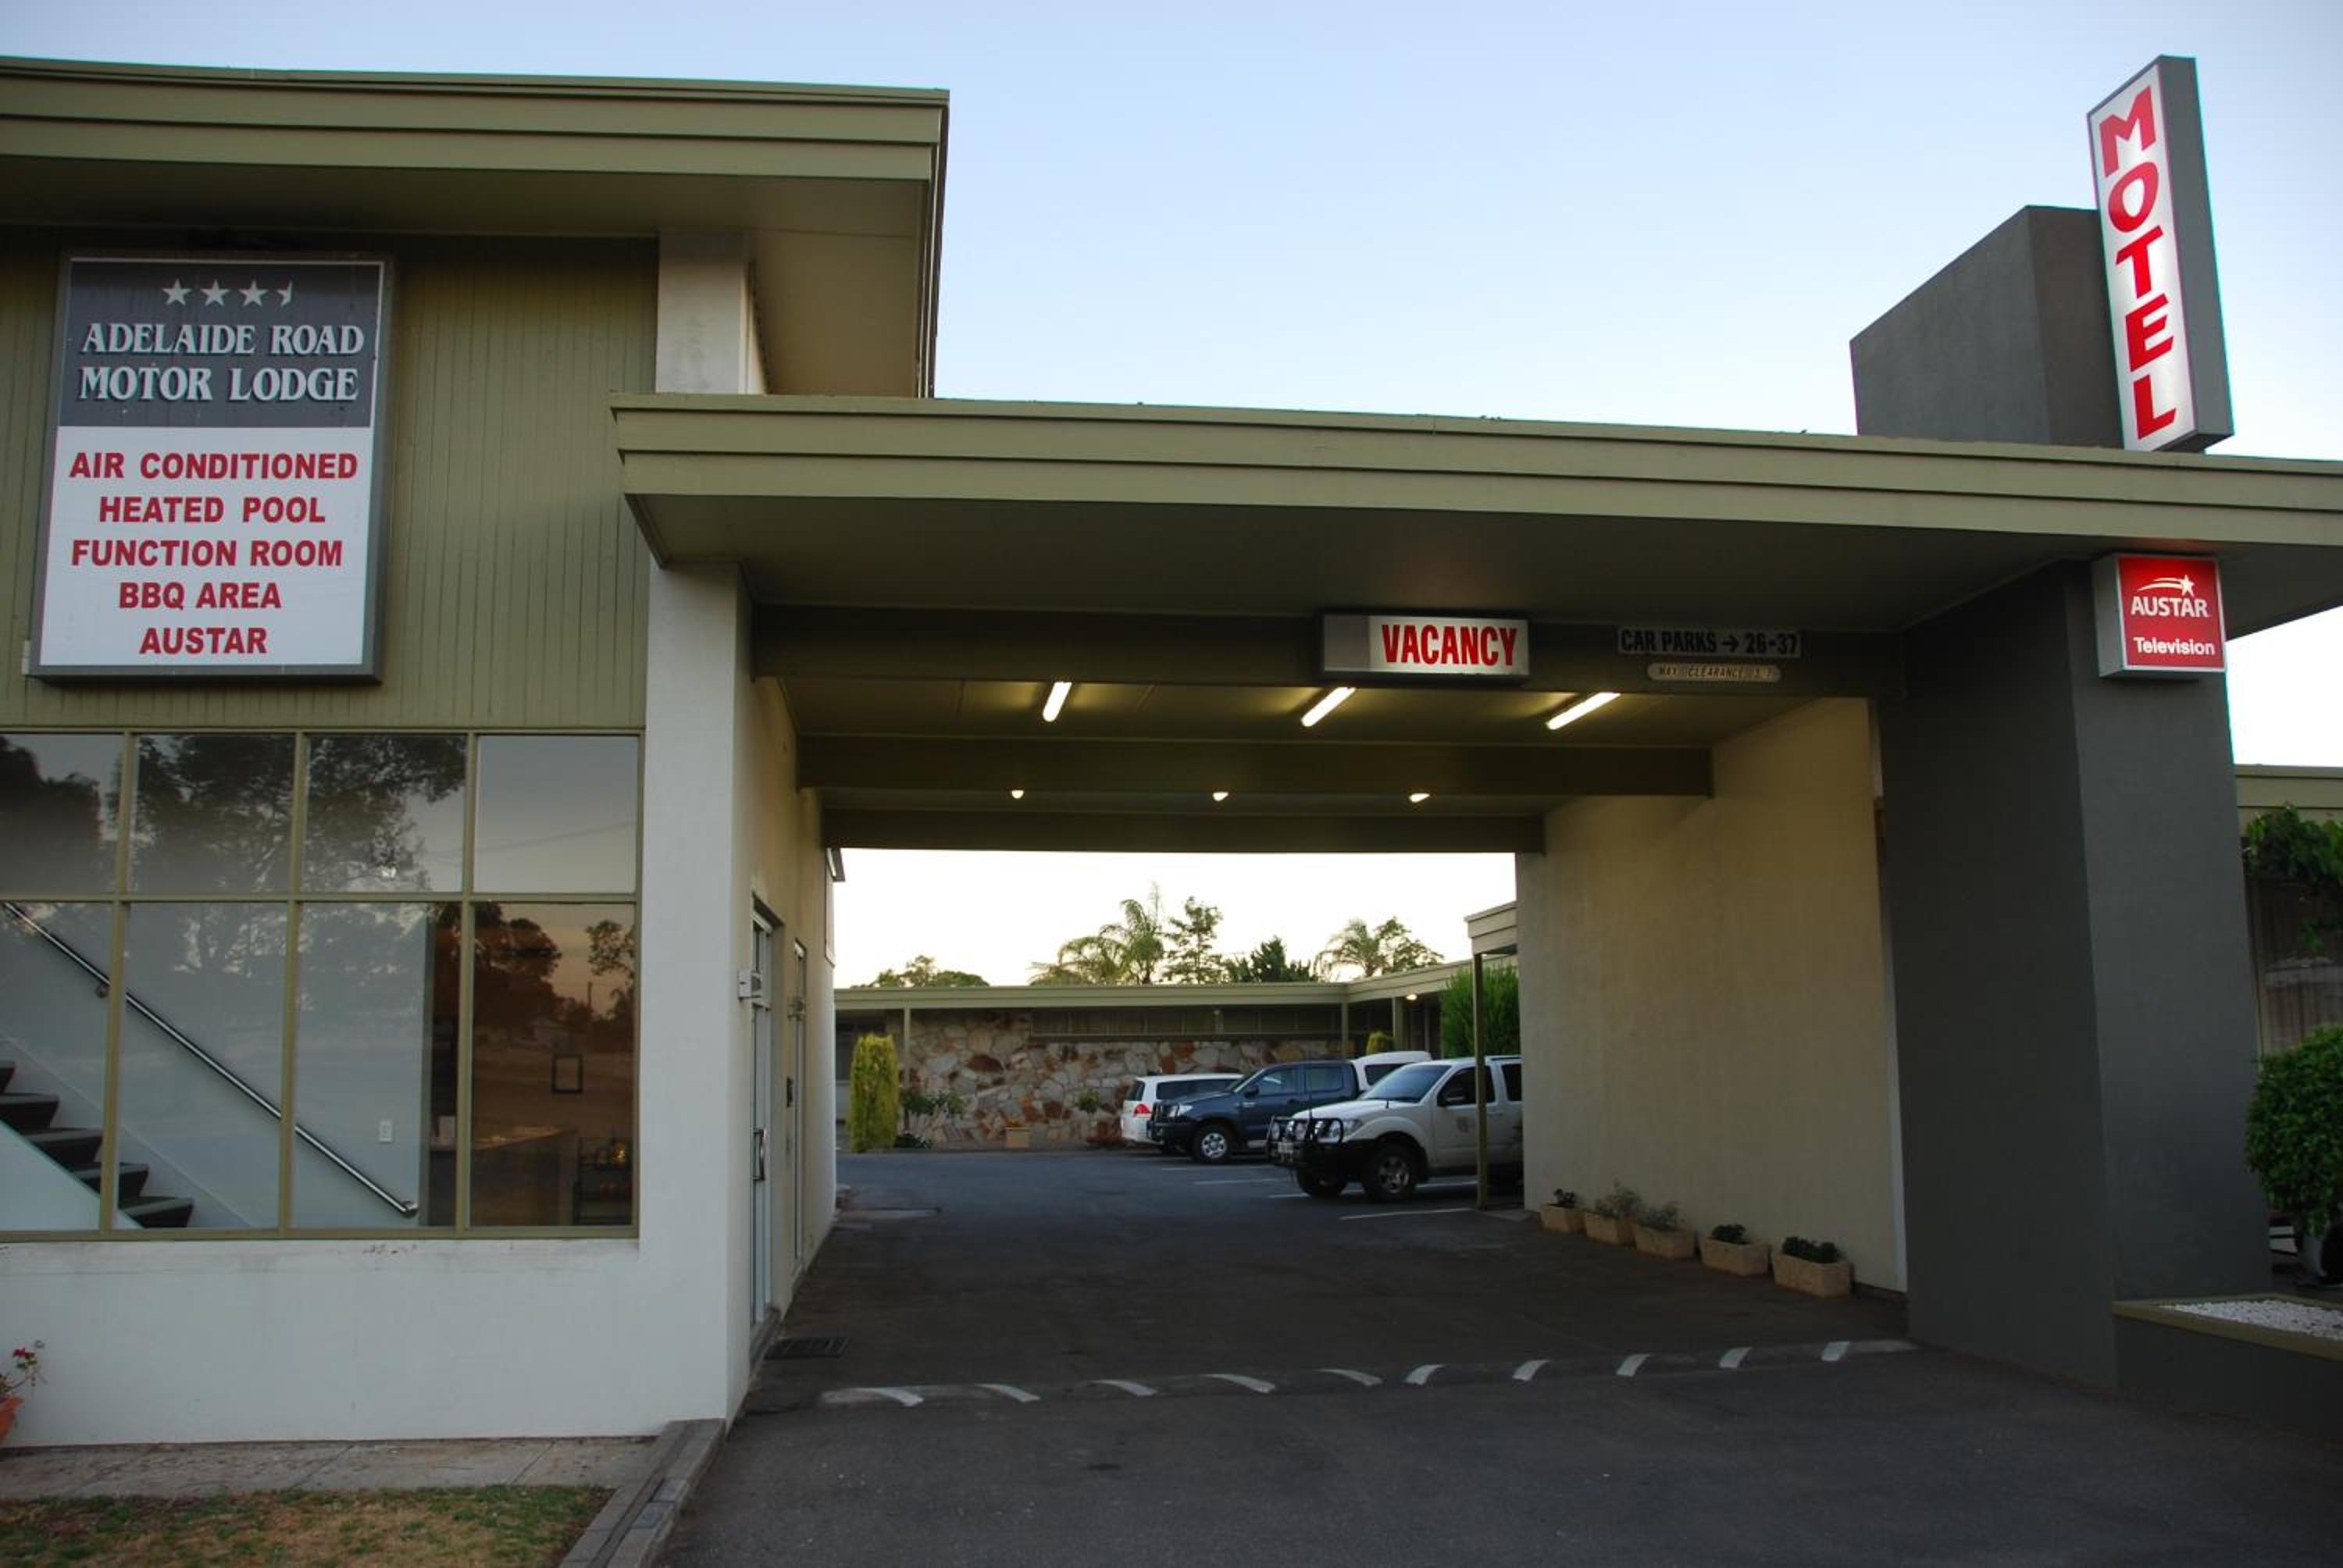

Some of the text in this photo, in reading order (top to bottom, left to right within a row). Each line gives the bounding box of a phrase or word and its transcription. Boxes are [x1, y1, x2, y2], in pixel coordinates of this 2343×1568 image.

[2099, 85, 2177, 440] MOTEL
[81, 323, 365, 355] ADELAIDE ROAD
[79, 366, 358, 401] MOTOR LODGE
[70, 452, 358, 479] AIR CONDITIONED
[99, 497, 326, 523] HEATED POOL
[71, 540, 342, 567] FUNCTION ROOM
[119, 582, 282, 610] BBQ AREA
[2131, 596, 2209, 618] AUSTAR
[139, 627, 267, 654] AUSTAR
[1381, 624, 1517, 666] VACANCY
[1621, 629, 1797, 654] CAR PARKS 26-37
[2133, 636, 2216, 655] Television
